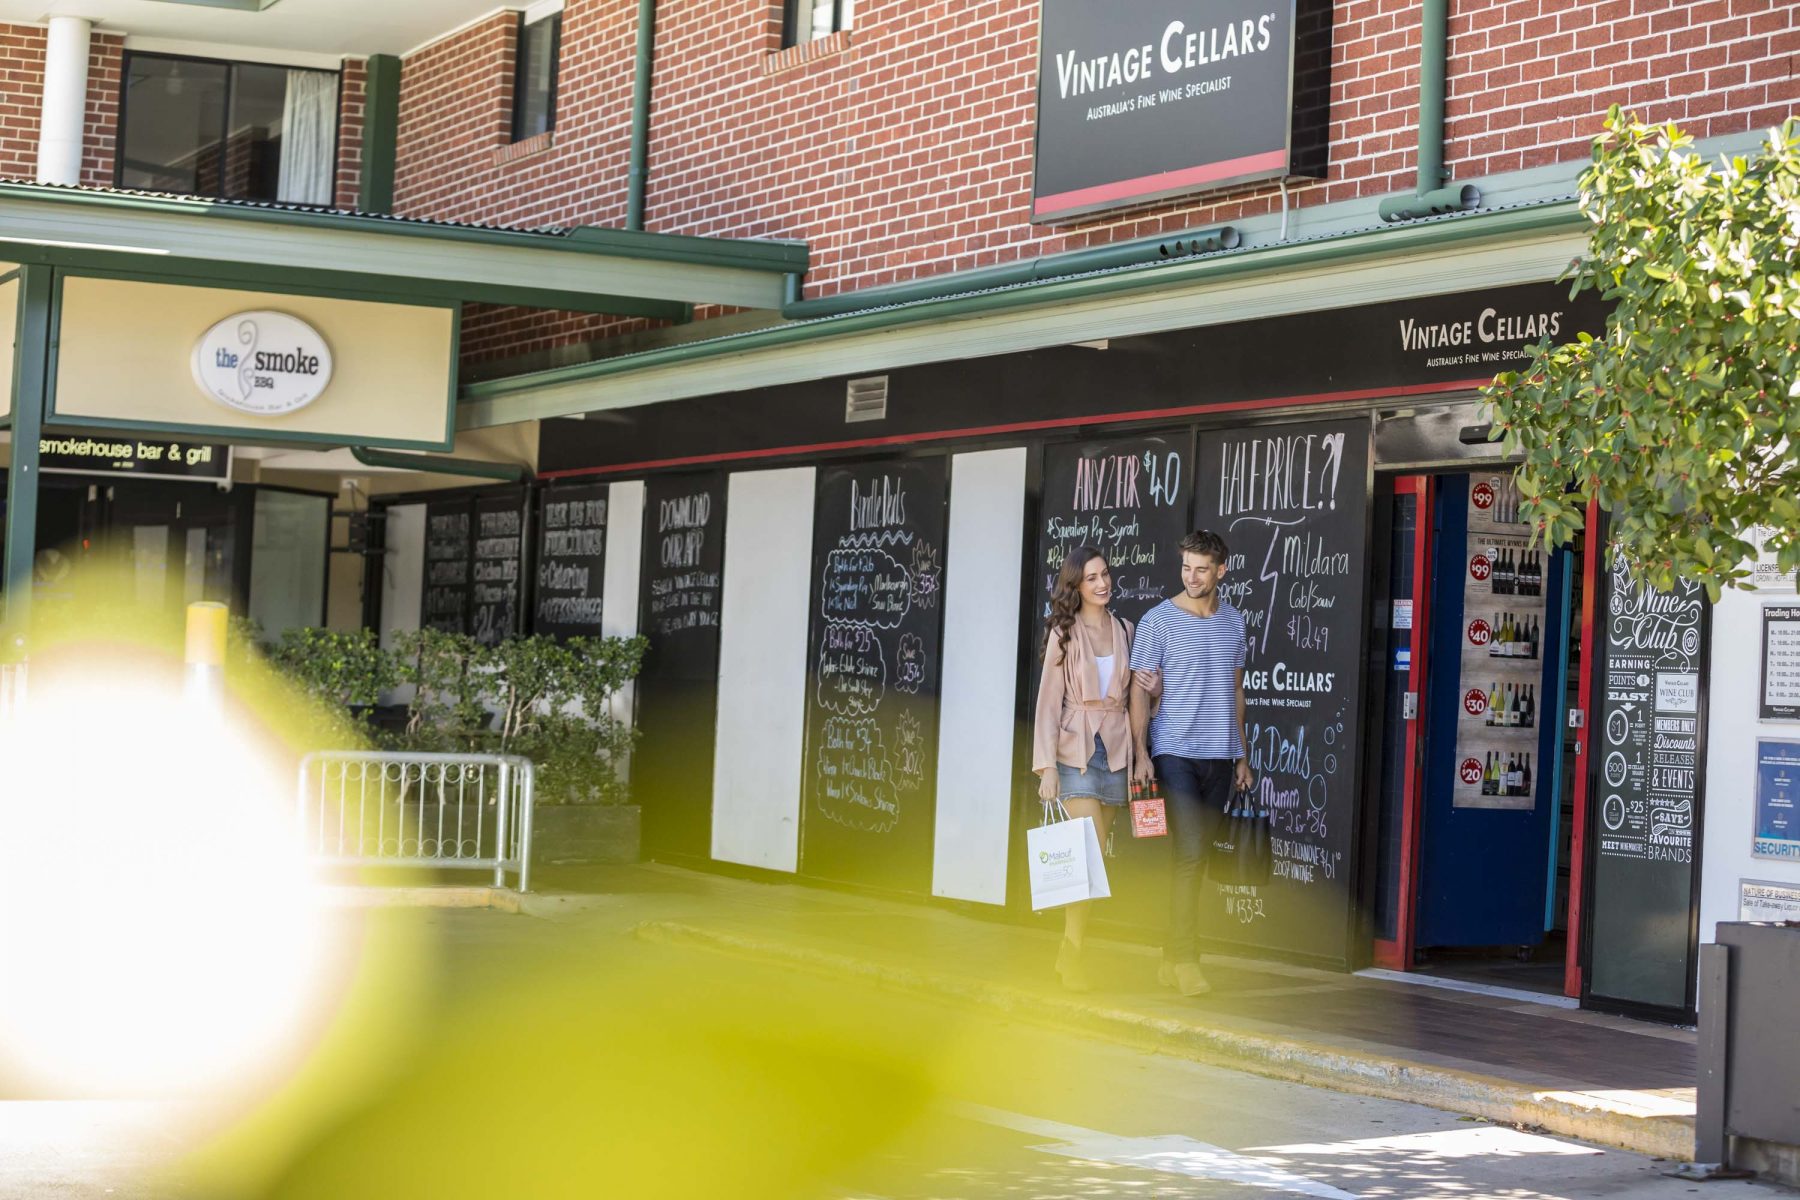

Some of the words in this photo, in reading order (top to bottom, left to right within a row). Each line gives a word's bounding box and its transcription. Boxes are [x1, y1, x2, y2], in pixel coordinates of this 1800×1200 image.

[1056, 45, 1153, 99] VINTAGE
[1086, 98, 1135, 121] AUSTRALIA'S
[1137, 93, 1156, 109] FINE
[1159, 87, 1183, 104] WINE
[1185, 76, 1232, 99] SPECIALIST
[1400, 318, 1472, 351] VINTAGE
[1477, 307, 1561, 343] CELLARS
[215, 347, 239, 369] the
[254, 347, 319, 376] smoke
[1426, 356, 1464, 368] AUSTRALIA'S
[1465, 353, 1480, 364] FINE
[1482, 352, 1500, 362] WINE
[1502, 350, 1533, 361] SPECIAL
[39, 437, 133, 458] smokehouse
[137, 442, 164, 460] bar
[167, 443, 182, 461] &
[186, 446, 212, 465] grill
[1073, 457, 1106, 511] ANY
[1103, 455, 1116, 509] 2
[1115, 455, 1141, 509] FOR
[1143, 450, 1181, 507] $40
[1473, 493, 1493, 505] $99
[659, 491, 711, 533] DOWNLOAD
[1471, 565, 1490, 577] $99
[1764, 608, 1790, 619] Trading
[1469, 630, 1489, 642] $40
[1631, 614, 1678, 650] Club
[1609, 659, 1651, 669] EARNING
[1272, 662, 1333, 692] CELLARS
[1608, 675, 1636, 686] POINTS
[1607, 692, 1650, 702] EASY
[1659, 688, 1677, 697] WINE
[1678, 688, 1695, 698] CLUB
[1259, 697, 1270, 706] FINE
[1272, 698, 1285, 707] WINE
[1286, 698, 1312, 708] SPECIALIST
[1466, 699, 1485, 712] $30
[1637, 709, 1643, 722] 1
[1611, 719, 1622, 736] $1
[1655, 719, 1680, 732] MEMBERS
[1680, 720, 1694, 733] ONLY
[1653, 733, 1696, 750] Discounts
[1263, 724, 1310, 780] Deals
[1636, 751, 1642, 764] 1
[1652, 752, 1695, 766] RELEASES
[1462, 768, 1480, 781] $20
[1608, 762, 1624, 773] 500
[1652, 768, 1659, 787] &
[1661, 768, 1694, 790] EVENTS
[1260, 776, 1300, 809] Mumm
[1630, 800, 1644, 814] $25
[1659, 812, 1684, 824] SAVE
[1601, 840, 1620, 851] MEET
[1649, 834, 1692, 848] FAVOURITE
[1647, 845, 1692, 864] BRANDS
